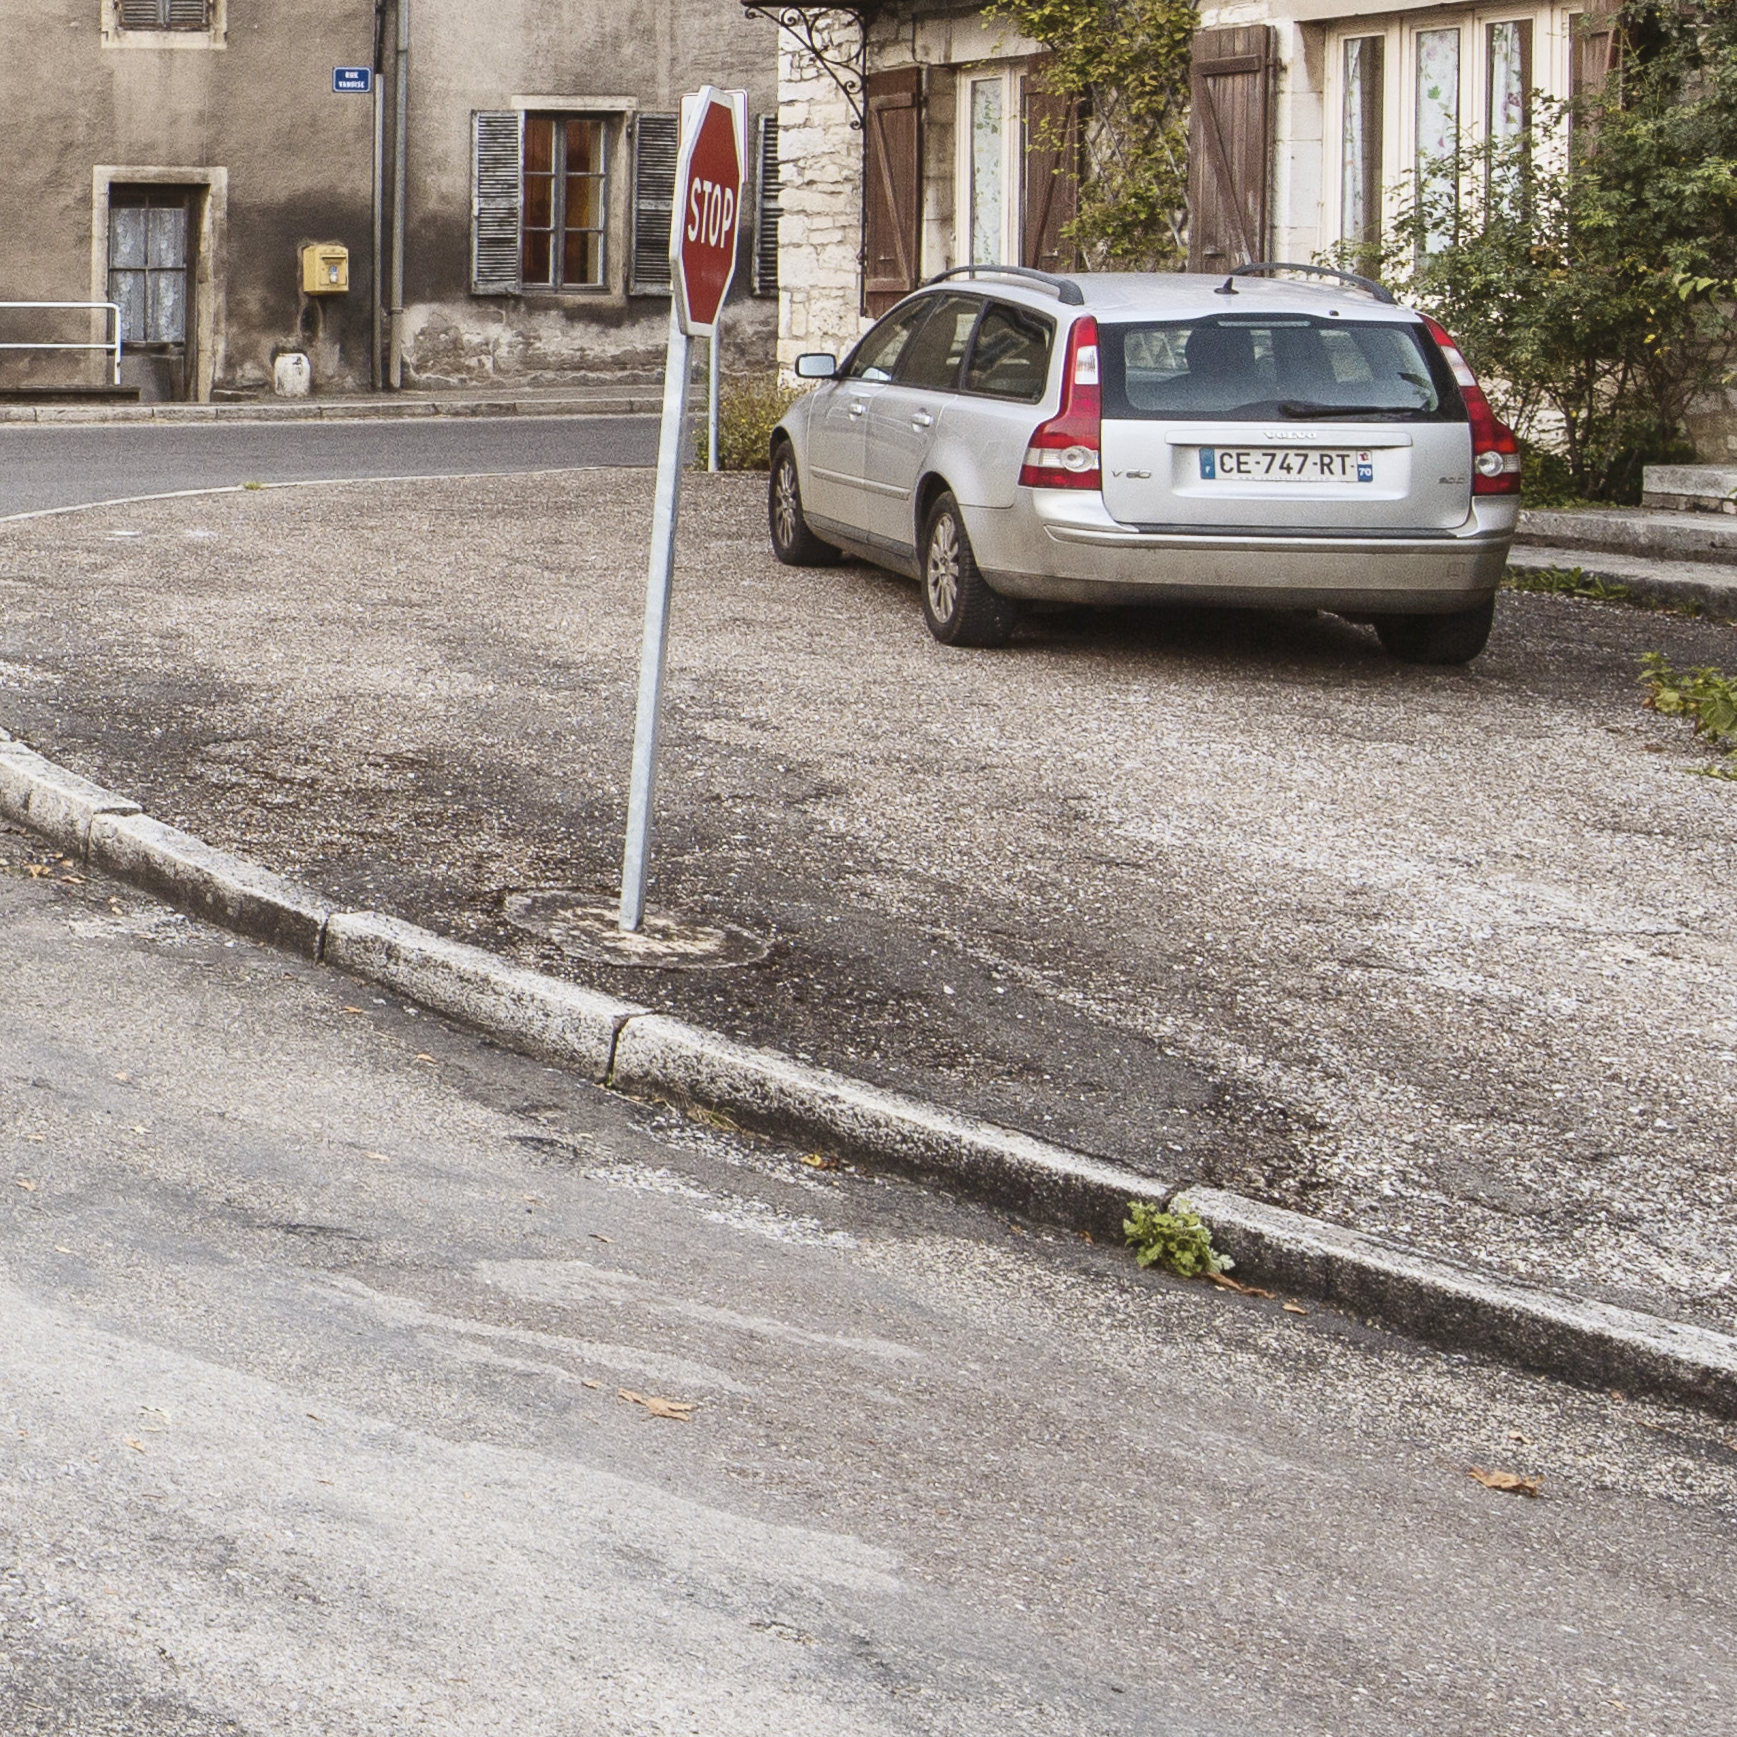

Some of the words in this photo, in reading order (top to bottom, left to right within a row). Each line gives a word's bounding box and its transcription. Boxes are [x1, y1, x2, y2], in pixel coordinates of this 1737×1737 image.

[345, 71, 359, 79] RUE
[688, 177, 734, 249] STOP
[1263, 431, 1318, 440] VOLVO
[1219, 452, 1351, 476] CE-747-RT
[1358, 467, 1372, 477] 70
